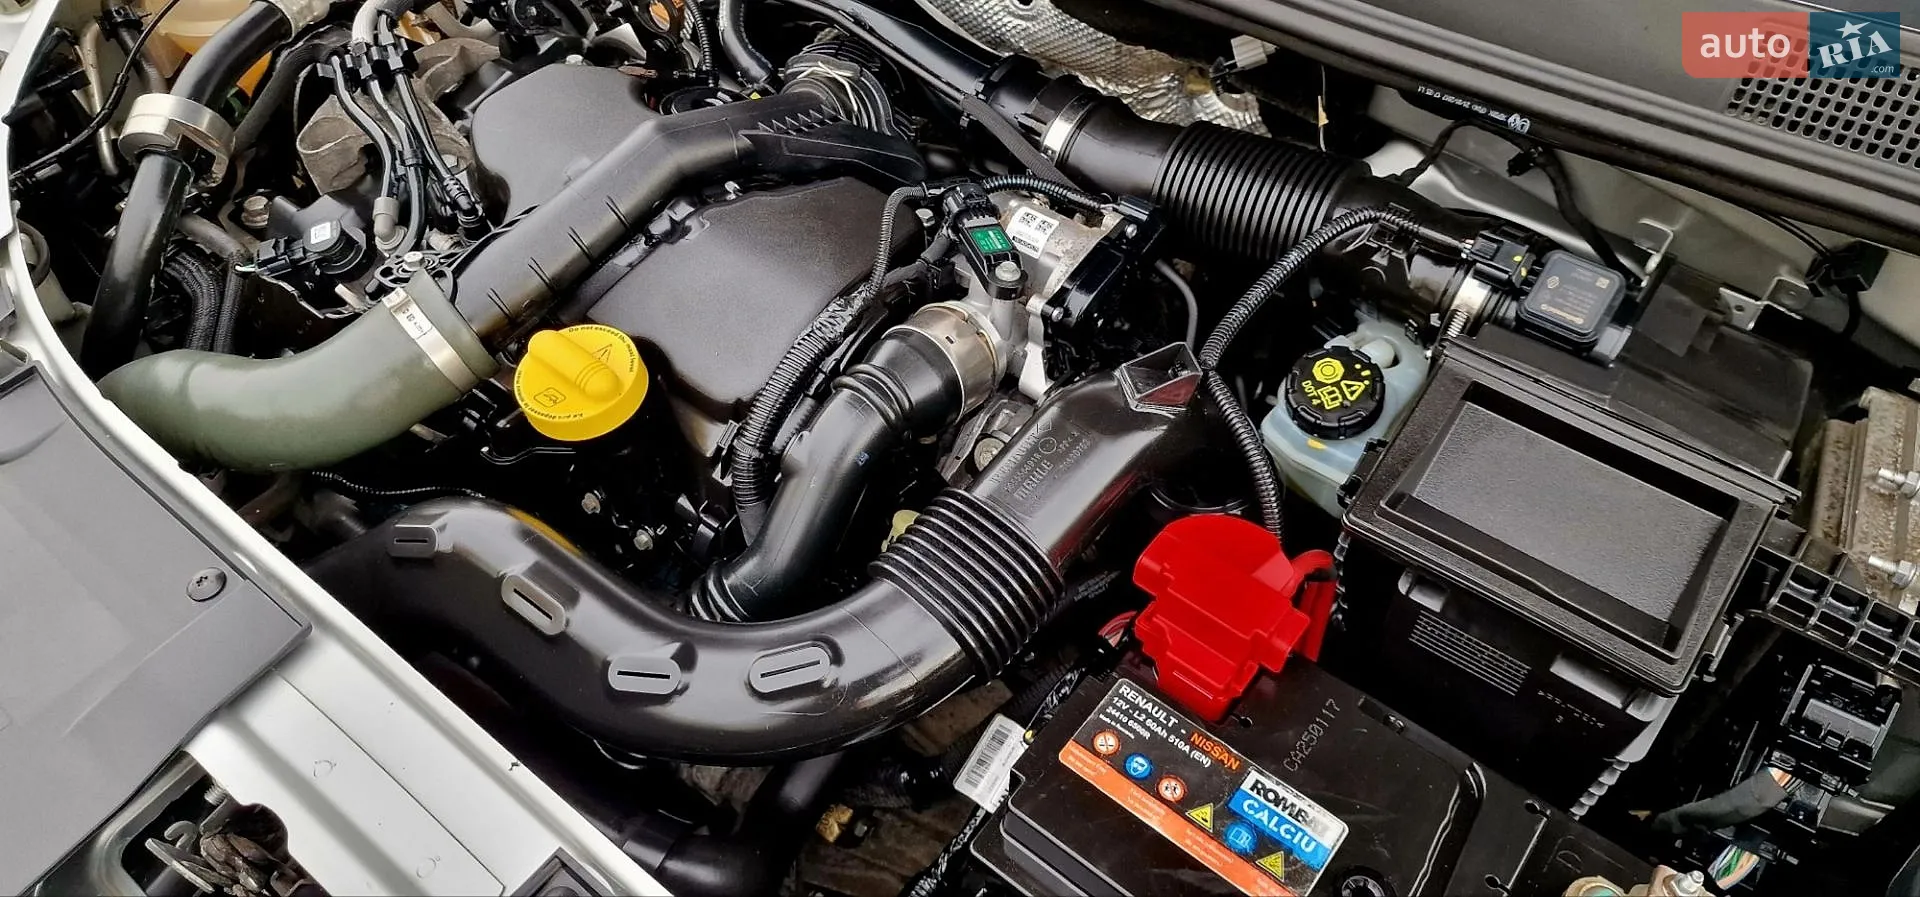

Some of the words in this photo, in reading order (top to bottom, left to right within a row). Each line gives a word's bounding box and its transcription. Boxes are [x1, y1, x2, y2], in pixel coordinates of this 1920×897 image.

[595, 326, 618, 336] exceed
[618, 332, 626, 344] the
[1302, 380, 1318, 397] DOT
[1112, 696, 1129, 710] 12V
[1133, 710, 1146, 722] L2
[1145, 719, 1168, 738] 60Ah
[1167, 734, 1190, 753] 510A
[1189, 748, 1211, 768] (EN)
[1118, 684, 1178, 728] RENAULT
[1190, 732, 1241, 770] NISSAN
[1283, 698, 1340, 771] CA250117
[1242, 799, 1317, 853] CALCIU
[1249, 779, 1325, 834] ROMB
